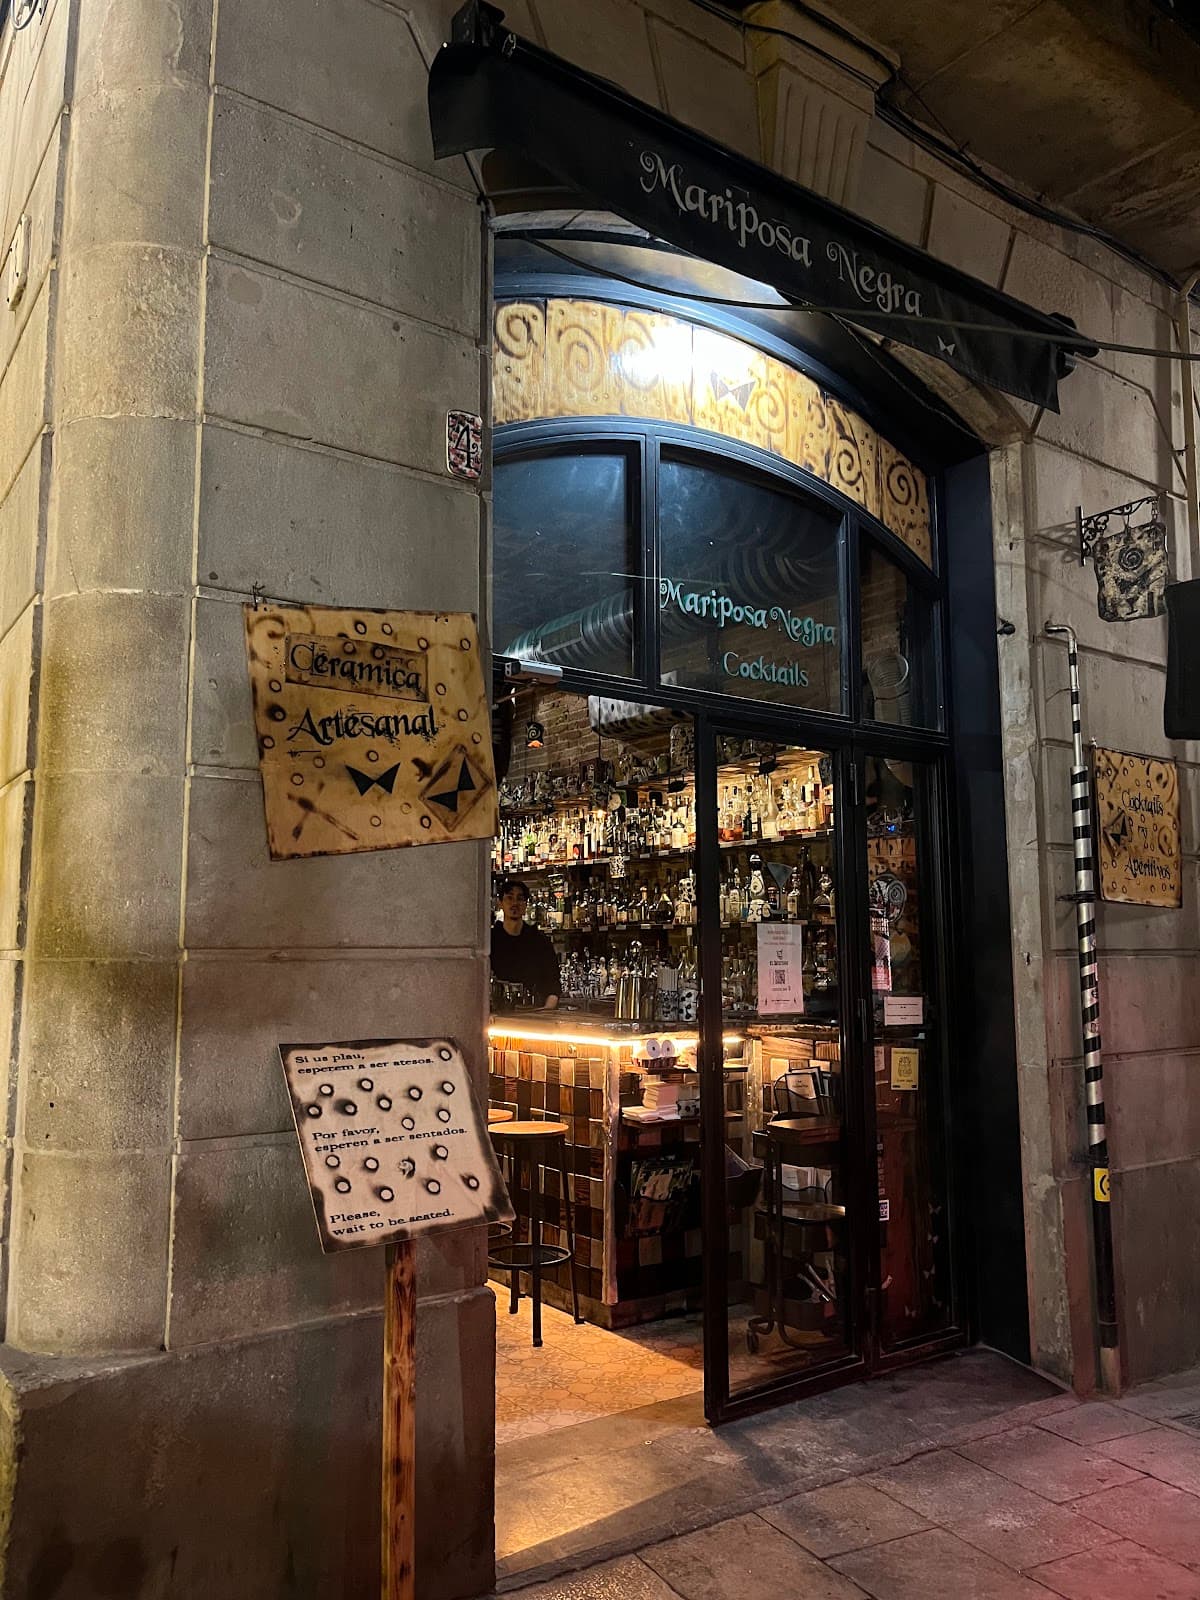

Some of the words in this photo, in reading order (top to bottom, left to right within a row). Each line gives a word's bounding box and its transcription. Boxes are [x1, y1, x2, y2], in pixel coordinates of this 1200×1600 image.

[639, 151, 813, 269] Mariposa
[826, 241, 924, 318] Negra
[455, 424, 479, 469] 4
[660, 578, 768, 629] Mariposa
[770, 606, 837, 646] Negra
[723, 651, 809, 688] Cocktails
[286, 704, 438, 746] Artesanal
[1121, 790, 1164, 816] Cocktails
[1124, 856, 1171, 879] Aperitivos
[297, 1064, 355, 1075] esperem
[332, 1053, 365, 1063] plau,
[312, 1132, 338, 1141] Por
[342, 1127, 380, 1137] favor,
[314, 1140, 369, 1152] esperen
[409, 1127, 468, 1139] sentados.
[330, 1210, 381, 1224] Please,
[332, 1224, 366, 1236] wait
[369, 1221, 384, 1229] to
[388, 1218, 406, 1226] be
[409, 1208, 455, 1221] seated.
